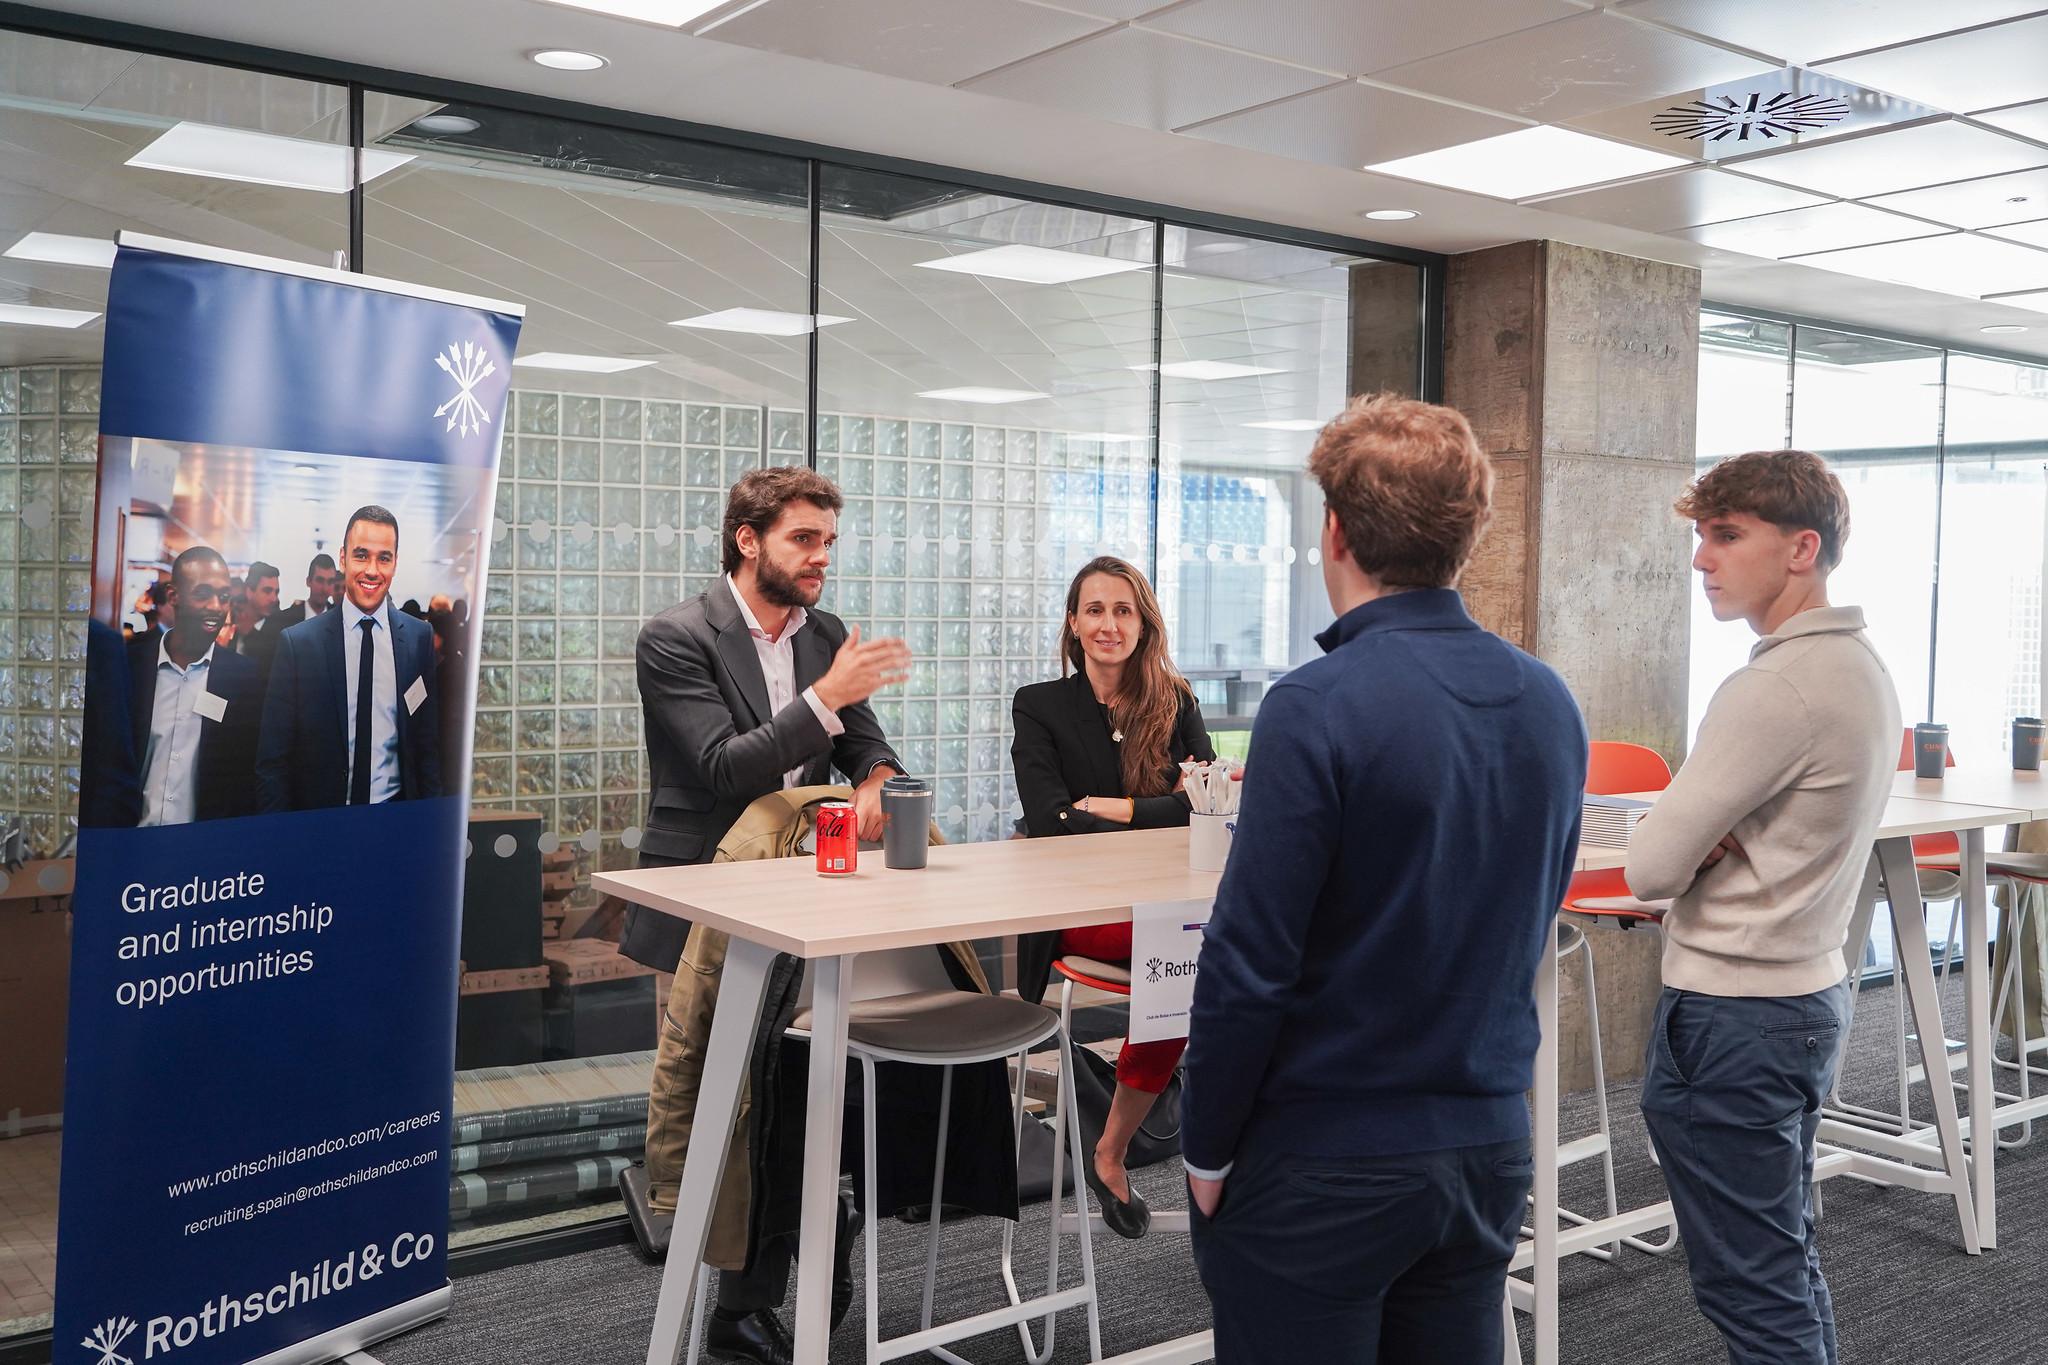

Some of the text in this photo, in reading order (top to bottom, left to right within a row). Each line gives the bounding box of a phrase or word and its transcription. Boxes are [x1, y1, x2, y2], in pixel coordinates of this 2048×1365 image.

[121, 871, 265, 914] Graduate
[118, 902, 334, 961] and internship
[115, 949, 315, 1009] opportunities
[1165, 960, 1198, 977] Roth
[168, 1109, 441, 1199] www.rothschildandco.com/careers
[184, 1149, 438, 1236] recruiting.spain@rothschildandco.com
[145, 1232, 434, 1359] Rothschild & Co
